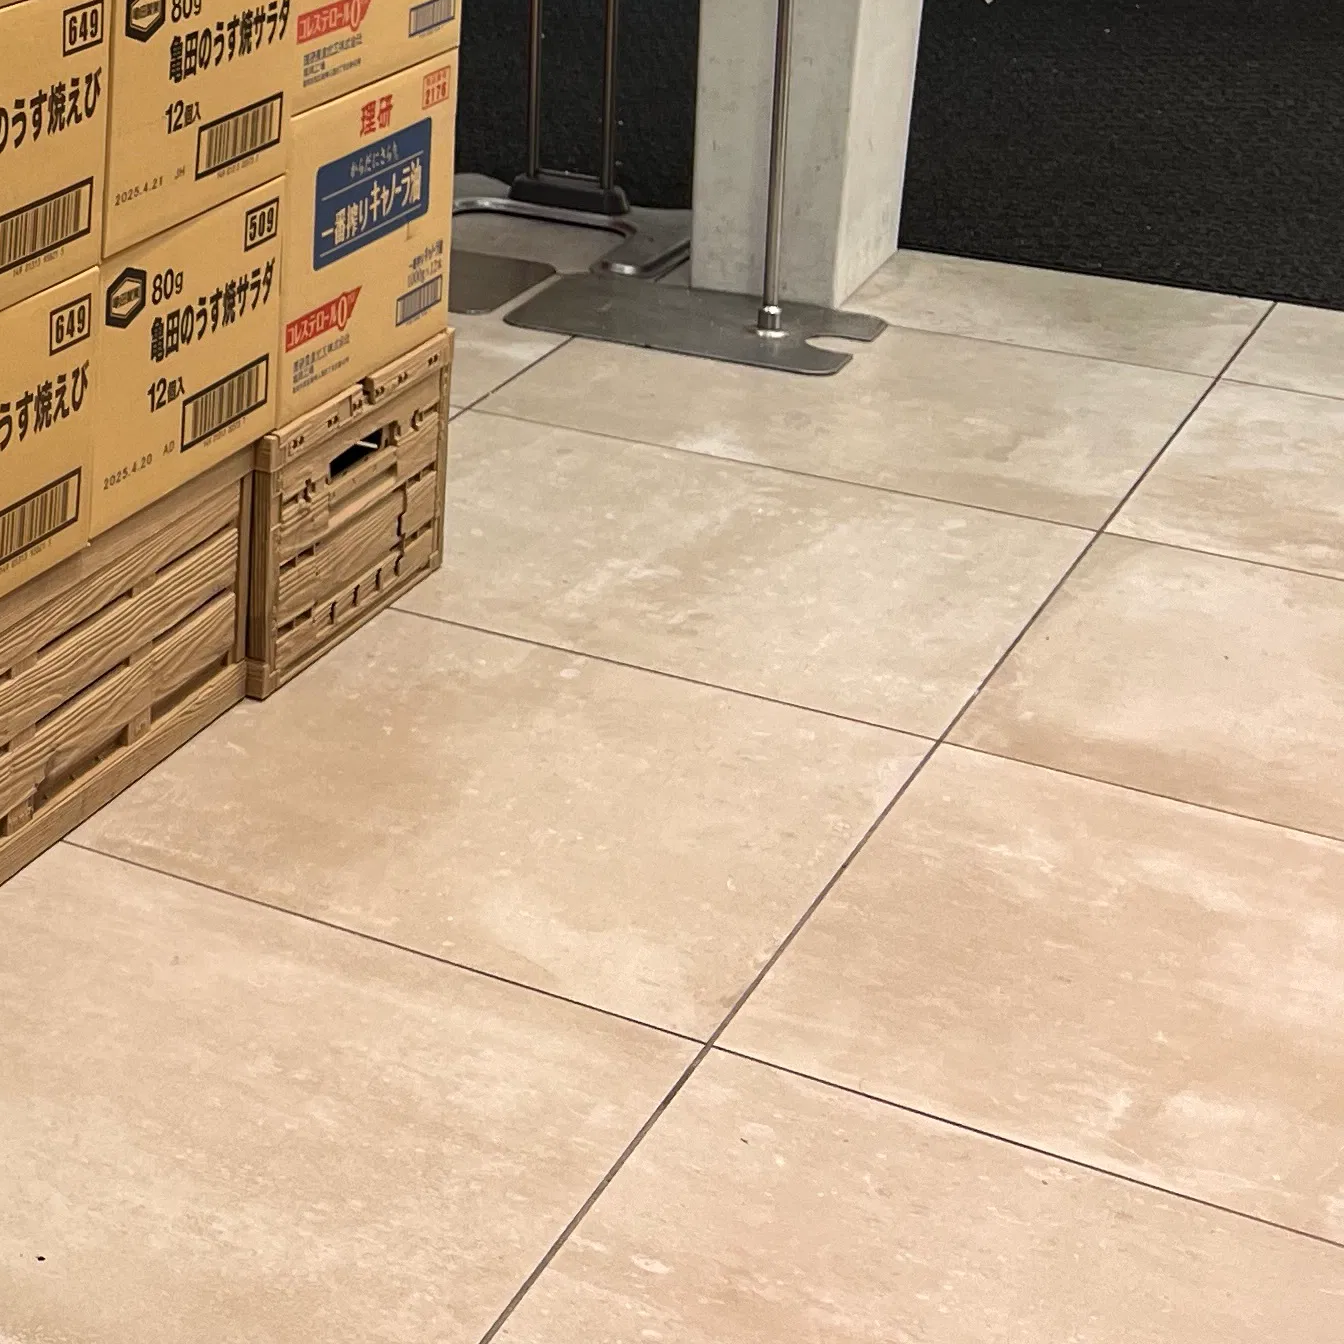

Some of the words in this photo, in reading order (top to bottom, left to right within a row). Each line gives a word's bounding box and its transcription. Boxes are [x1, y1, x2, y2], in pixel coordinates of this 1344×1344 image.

[68, 7, 99, 46] 649
[164, 99, 201, 135] 12個入
[359, 94, 394, 138] 理研
[321, 159, 422, 247] 一番搾りキャノーラ油
[248, 206, 274, 240] 509
[152, 268, 184, 306] 80g
[54, 304, 86, 345] 649
[150, 257, 276, 364] 亀田のうす焼サラダ
[147, 375, 185, 413] 12個入
